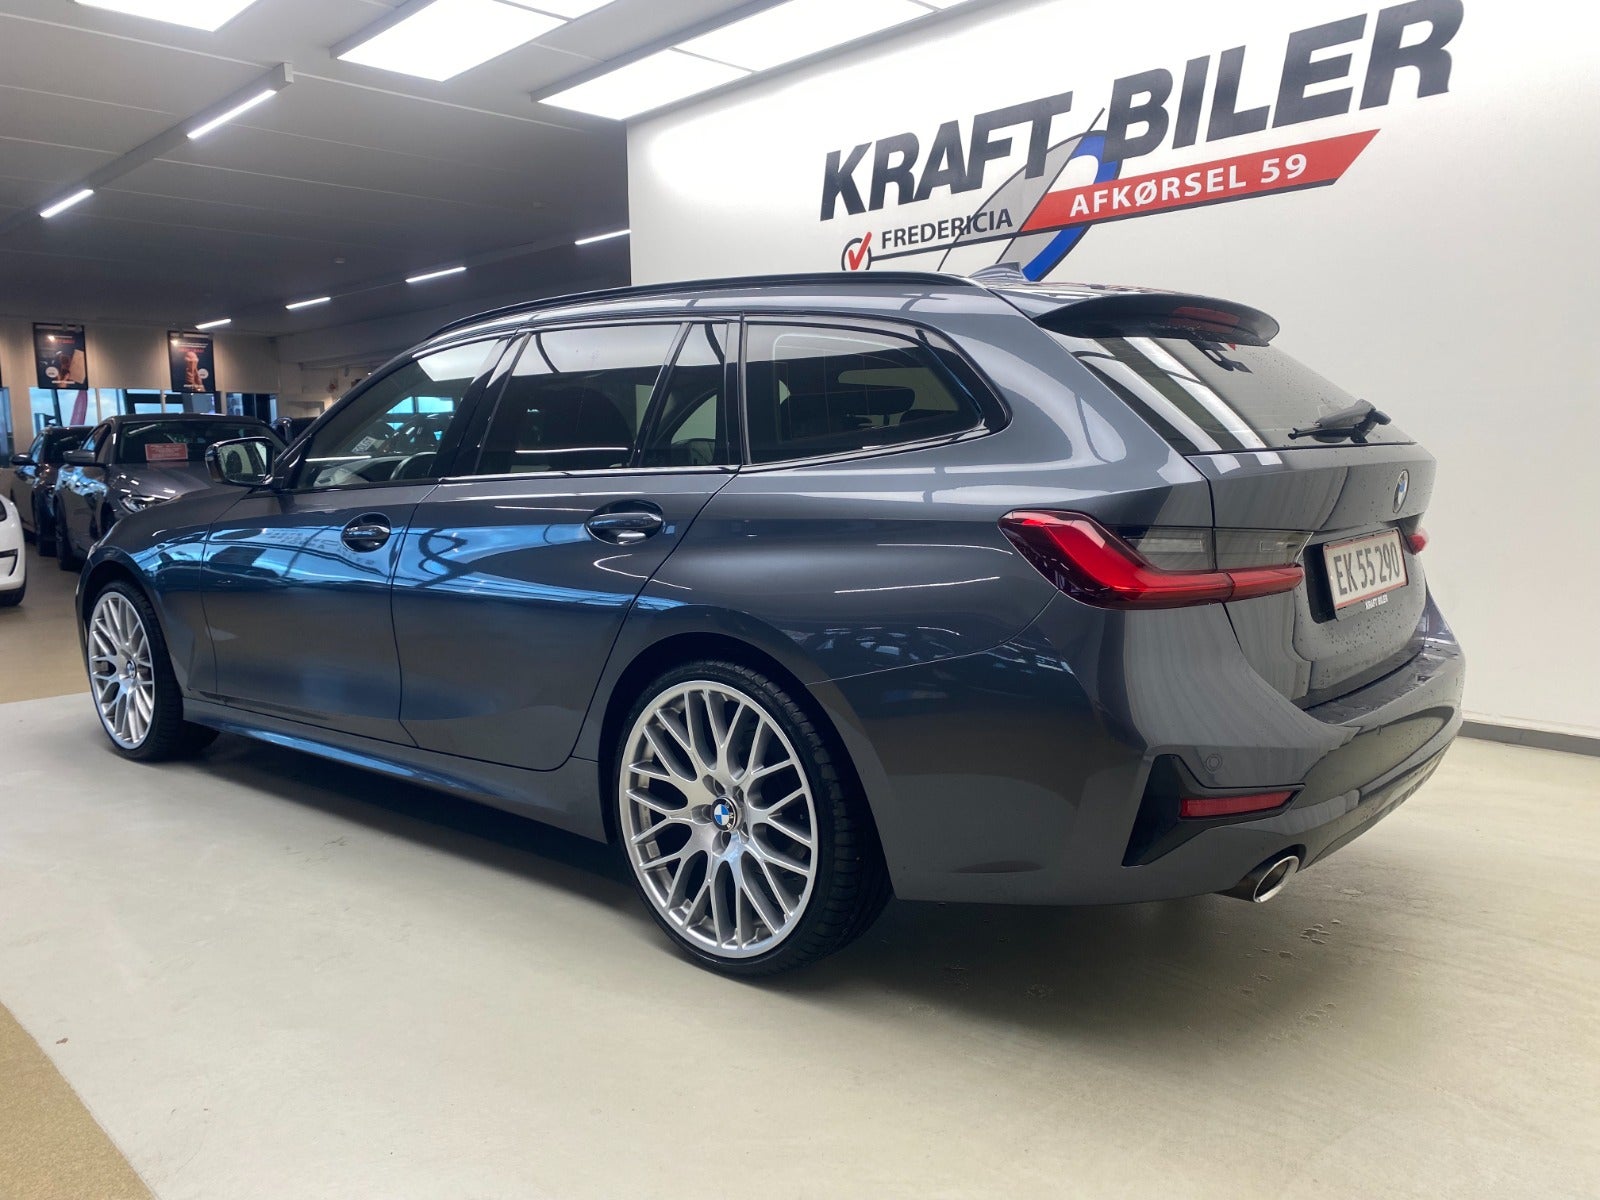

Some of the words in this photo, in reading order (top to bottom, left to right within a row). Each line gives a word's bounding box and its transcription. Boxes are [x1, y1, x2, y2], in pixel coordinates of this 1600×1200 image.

[819, 90, 1073, 221] KRAFT
[1102, 0, 1465, 163] BILER
[1069, 164, 1247, 216] AFKØRSEL
[1260, 153, 1307, 184] 59
[881, 208, 1013, 249] FREDERICIA
[1333, 551, 1358, 596] EK
[1357, 547, 1376, 589] 55
[1375, 541, 1400, 584] 290
